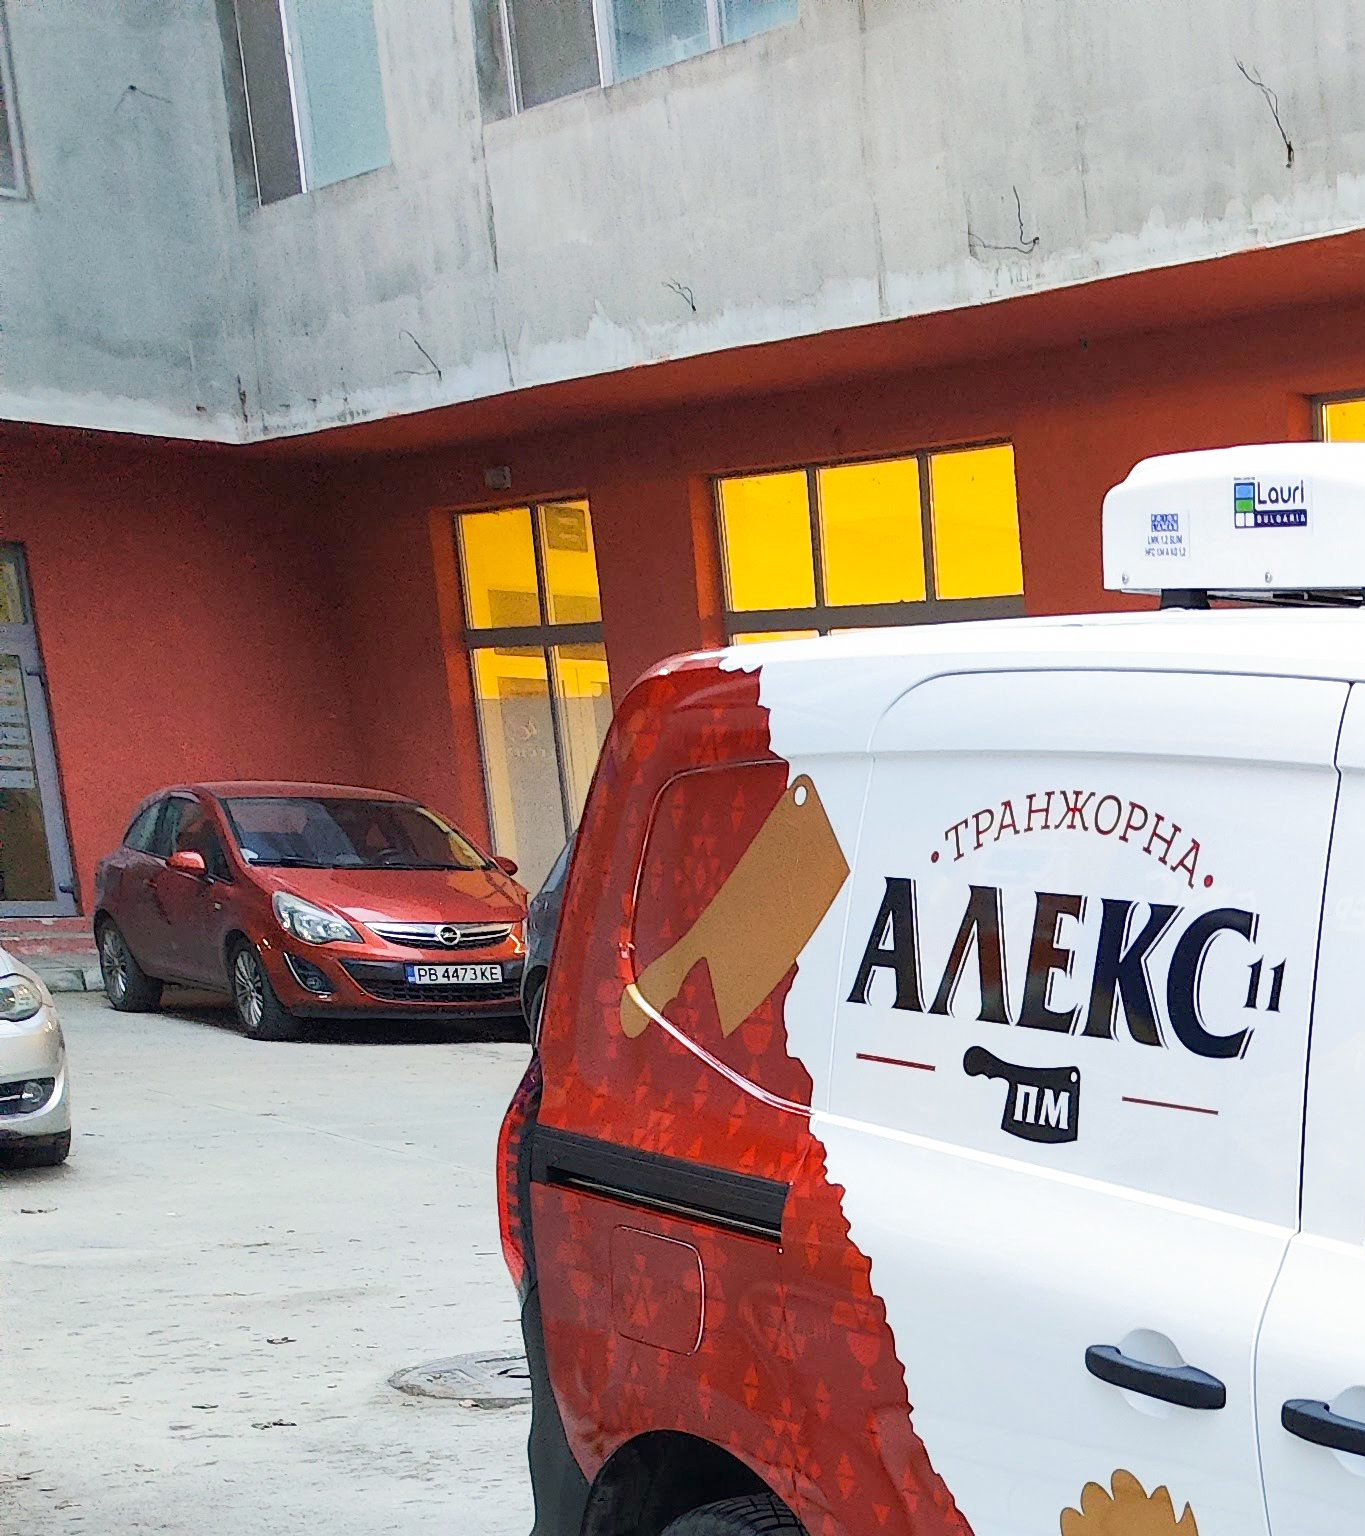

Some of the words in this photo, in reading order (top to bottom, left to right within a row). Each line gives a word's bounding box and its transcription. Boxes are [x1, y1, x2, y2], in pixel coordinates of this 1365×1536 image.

[1257, 479, 1305, 505] Lauri
[1256, 513, 1306, 524] BULGARIA
[944, 789, 1201, 888] ТРАНЖОРНА
[845, 876, 1261, 1060] АЛЕКС
[1012, 1083, 1071, 1130] ПМ
